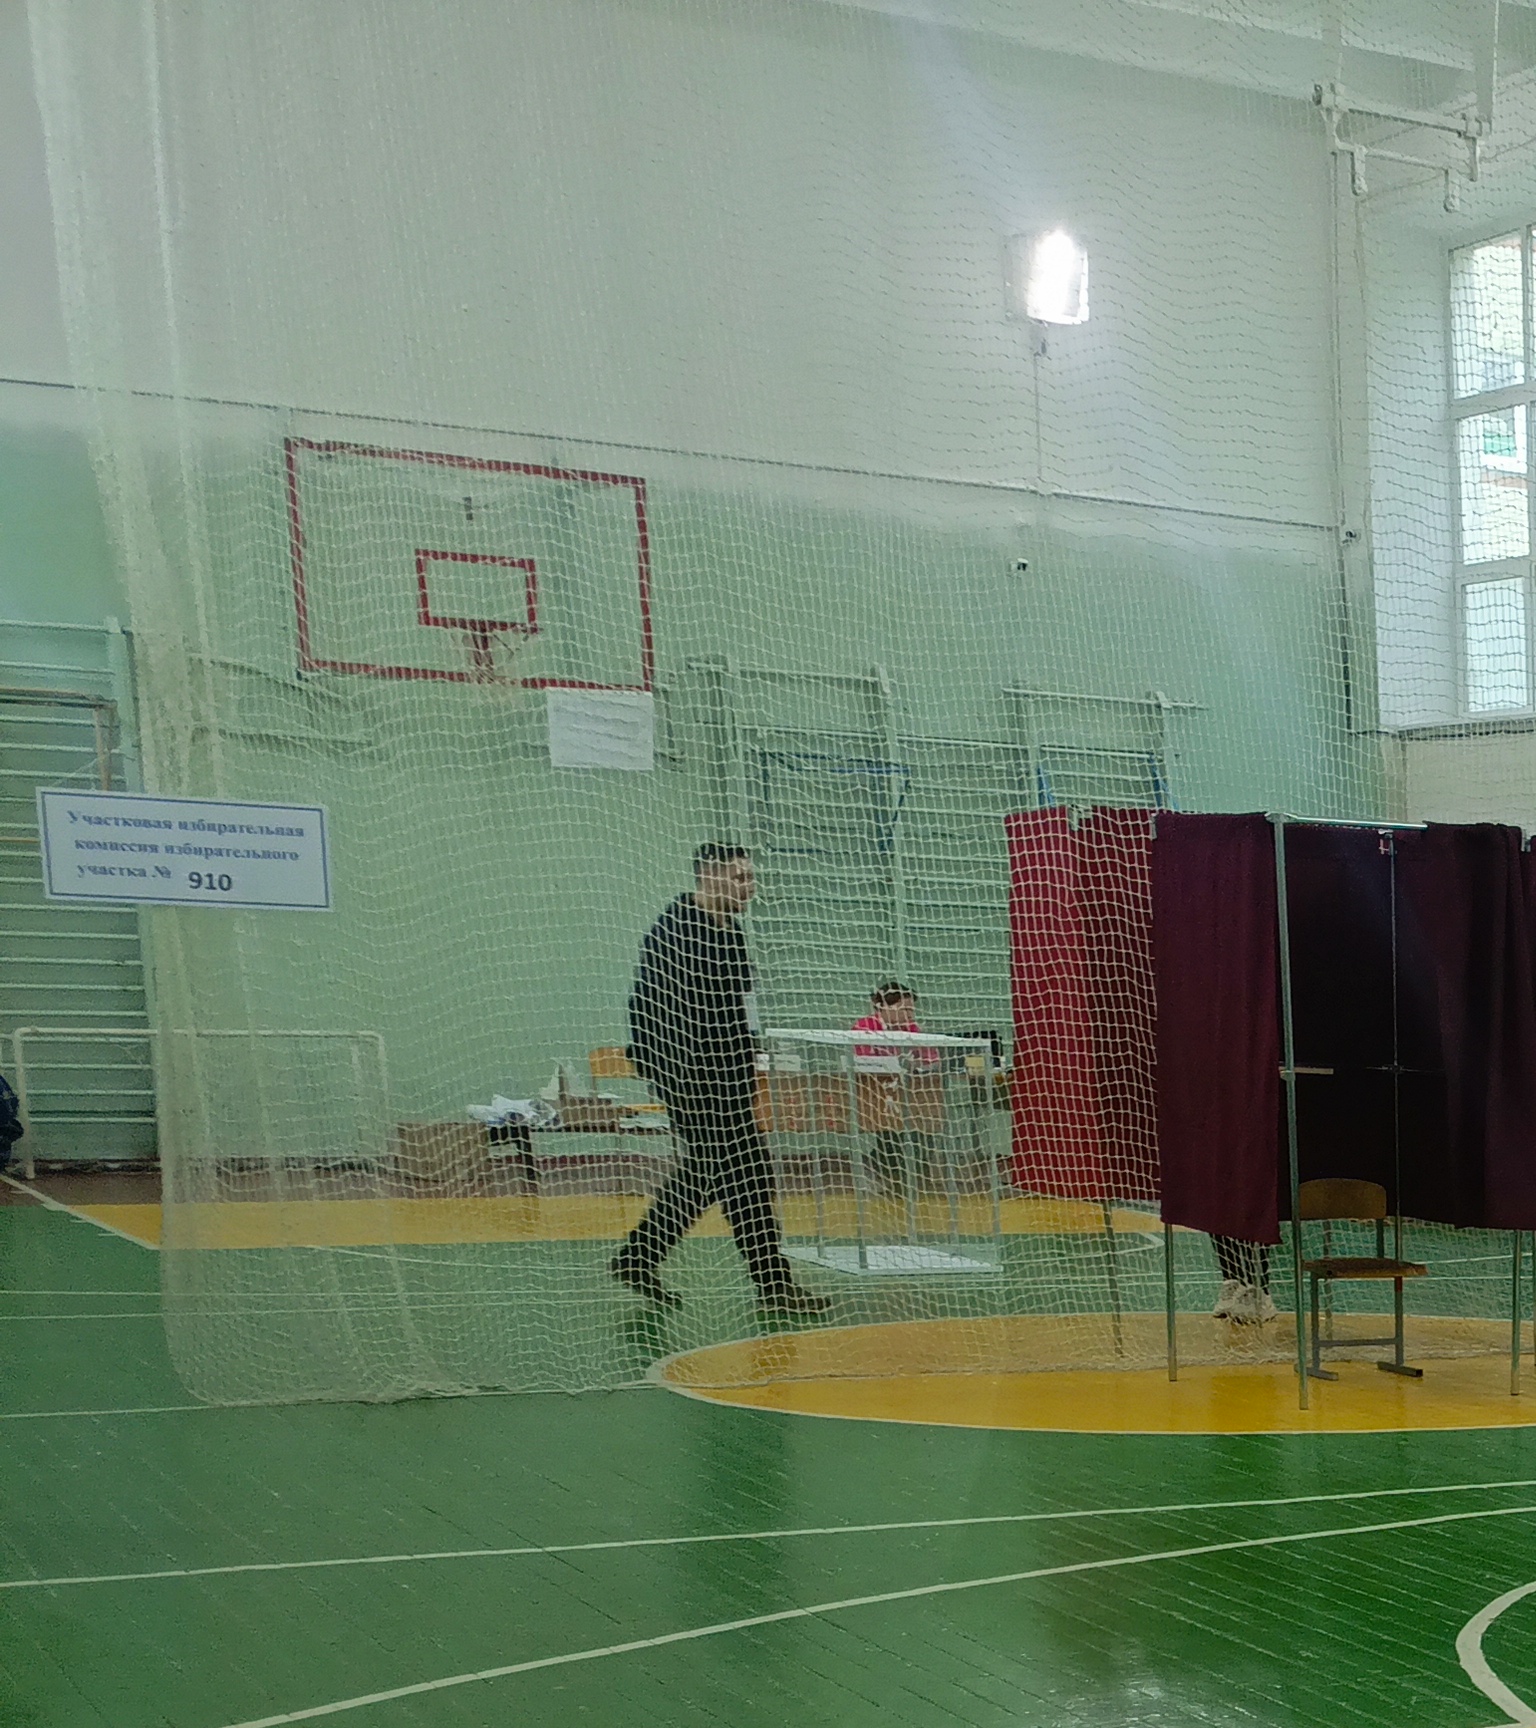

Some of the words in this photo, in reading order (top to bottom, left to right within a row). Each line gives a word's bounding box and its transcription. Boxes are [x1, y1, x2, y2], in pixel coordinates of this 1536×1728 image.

[66, 809, 172, 831] Участковая
[178, 817, 304, 837] избирательная
[75, 838, 158, 855] комиссия
[164, 841, 299, 862] избирательного
[76, 863, 147, 878] участка
[151, 864, 171, 879] №
[187, 871, 233, 892] 910
